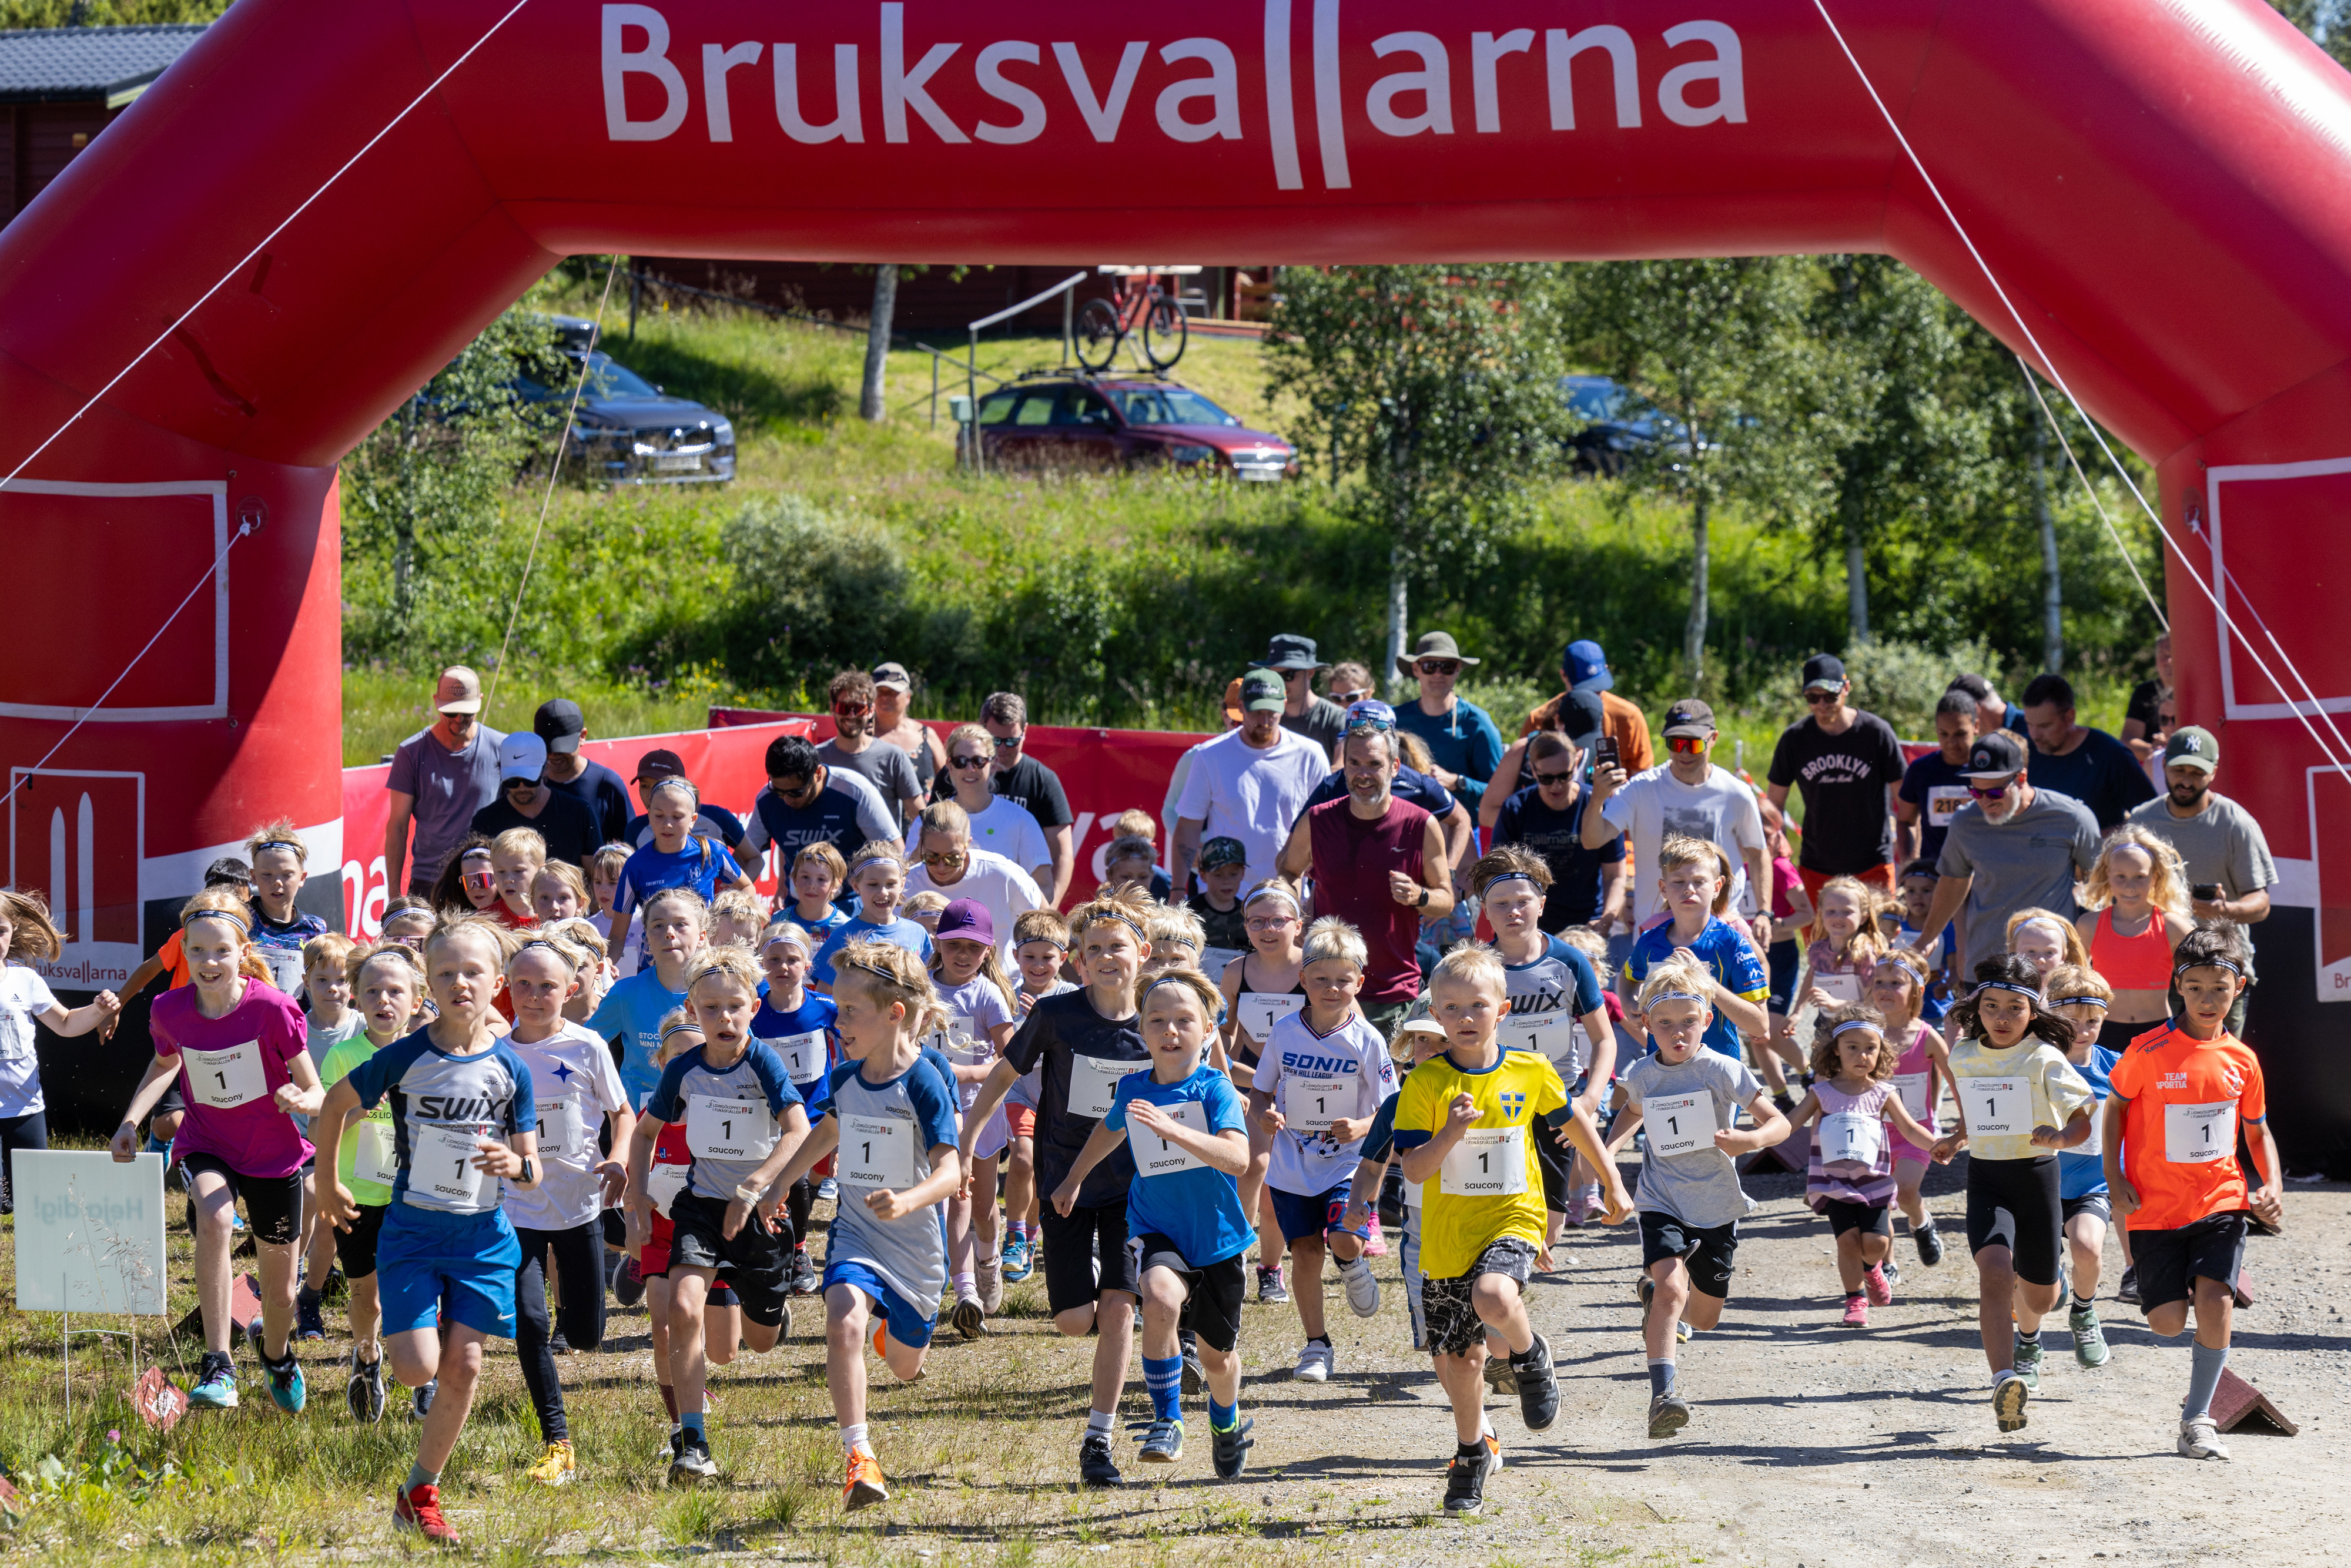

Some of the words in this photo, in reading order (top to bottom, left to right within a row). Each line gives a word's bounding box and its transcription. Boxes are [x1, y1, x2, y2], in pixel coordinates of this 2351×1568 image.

[601, 0, 1748, 190] Bruksvallarna
[2185, 735, 2202, 752] NY
[1801, 754, 1871, 781] BROOKLYN
[1744, 895, 1749, 908] 1
[33, 960, 127, 983] ruksvallarna
[272, 966, 279, 981] 1
[1506, 987, 1565, 1015] wix
[1266, 1011, 1274, 1027] 1
[935, 1033, 942, 1050] 1
[1528, 1033, 1537, 1050] 1
[2144, 1038, 2169, 1054] Kempa
[791, 1052, 800, 1068] 1
[1282, 1051, 1359, 1073] SONIC
[215, 1071, 226, 1090] 1
[1298, 1070, 1310, 1078] HILL
[2164, 1073, 2187, 1081] TEAM
[1108, 1081, 1117, 1100] 1
[2156, 1081, 2187, 1089] SPORTIA
[211, 1093, 243, 1103] saucony
[1316, 1097, 1324, 1114] 1
[885, 1105, 911, 1116] saucony
[1987, 1098, 1995, 1117] 1
[535, 1118, 545, 1138] 1
[722, 1120, 731, 1140] 1
[1667, 1116, 1679, 1135] 1
[2201, 1124, 2209, 1143] 1
[1846, 1128, 1854, 1143] 1
[708, 1146, 744, 1156] saucony
[862, 1141, 870, 1164] 1
[1660, 1140, 1694, 1151] saucony
[1837, 1149, 1865, 1157] saucony
[2190, 1148, 2219, 1158] saucony
[454, 1158, 465, 1180] 1
[1150, 1157, 1185, 1169] saucony
[1478, 1151, 1488, 1174] 1
[850, 1171, 885, 1182] saucony
[435, 1184, 473, 1199] saucony
[1464, 1181, 1504, 1190] saucony
